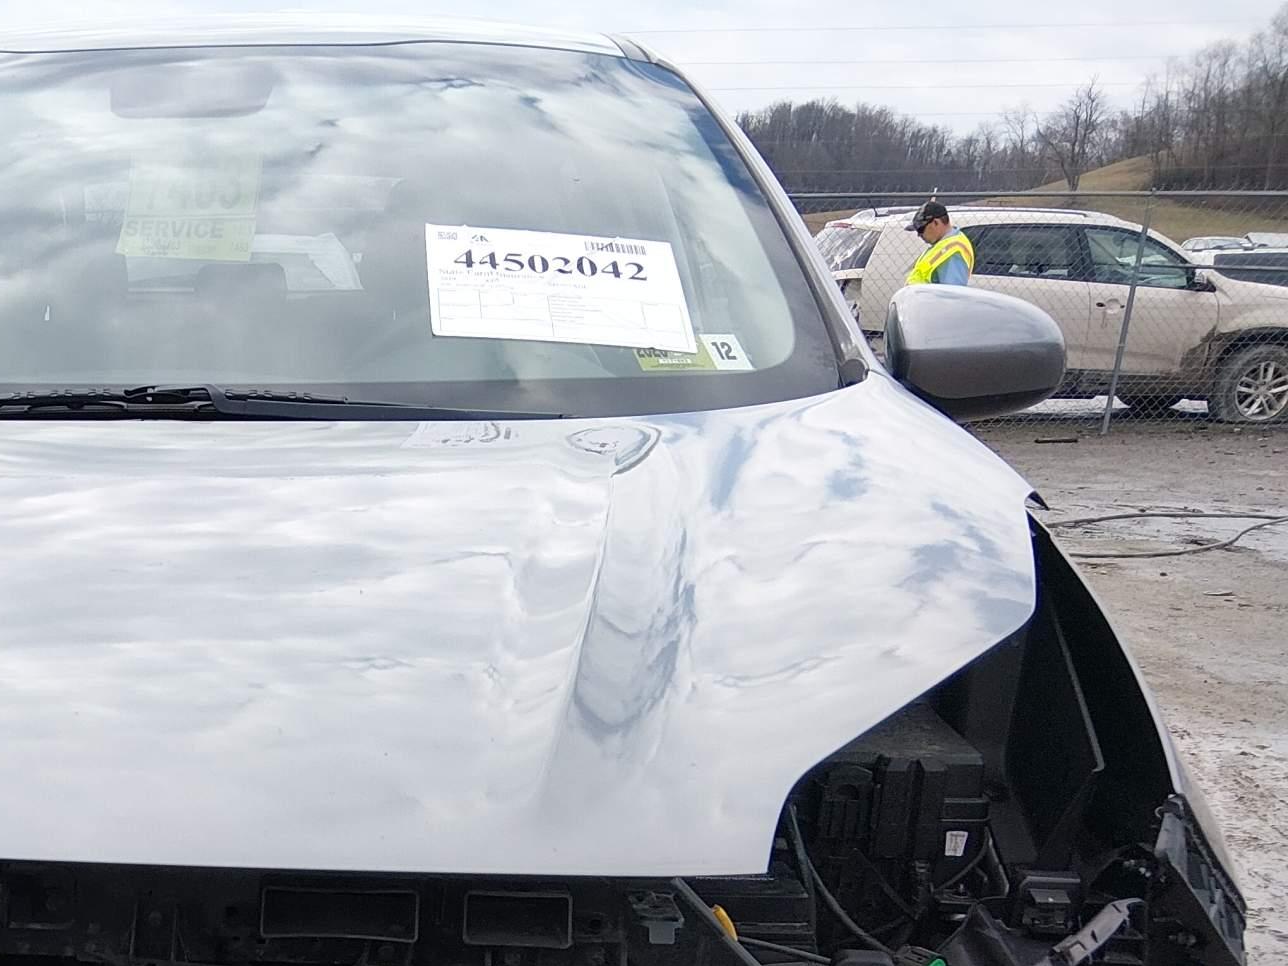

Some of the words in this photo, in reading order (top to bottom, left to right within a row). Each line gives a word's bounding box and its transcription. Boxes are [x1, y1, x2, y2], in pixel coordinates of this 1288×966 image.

[124, 219, 225, 239] SERVICE
[453, 248, 648, 281] 44502042
[710, 341, 738, 360] 12
